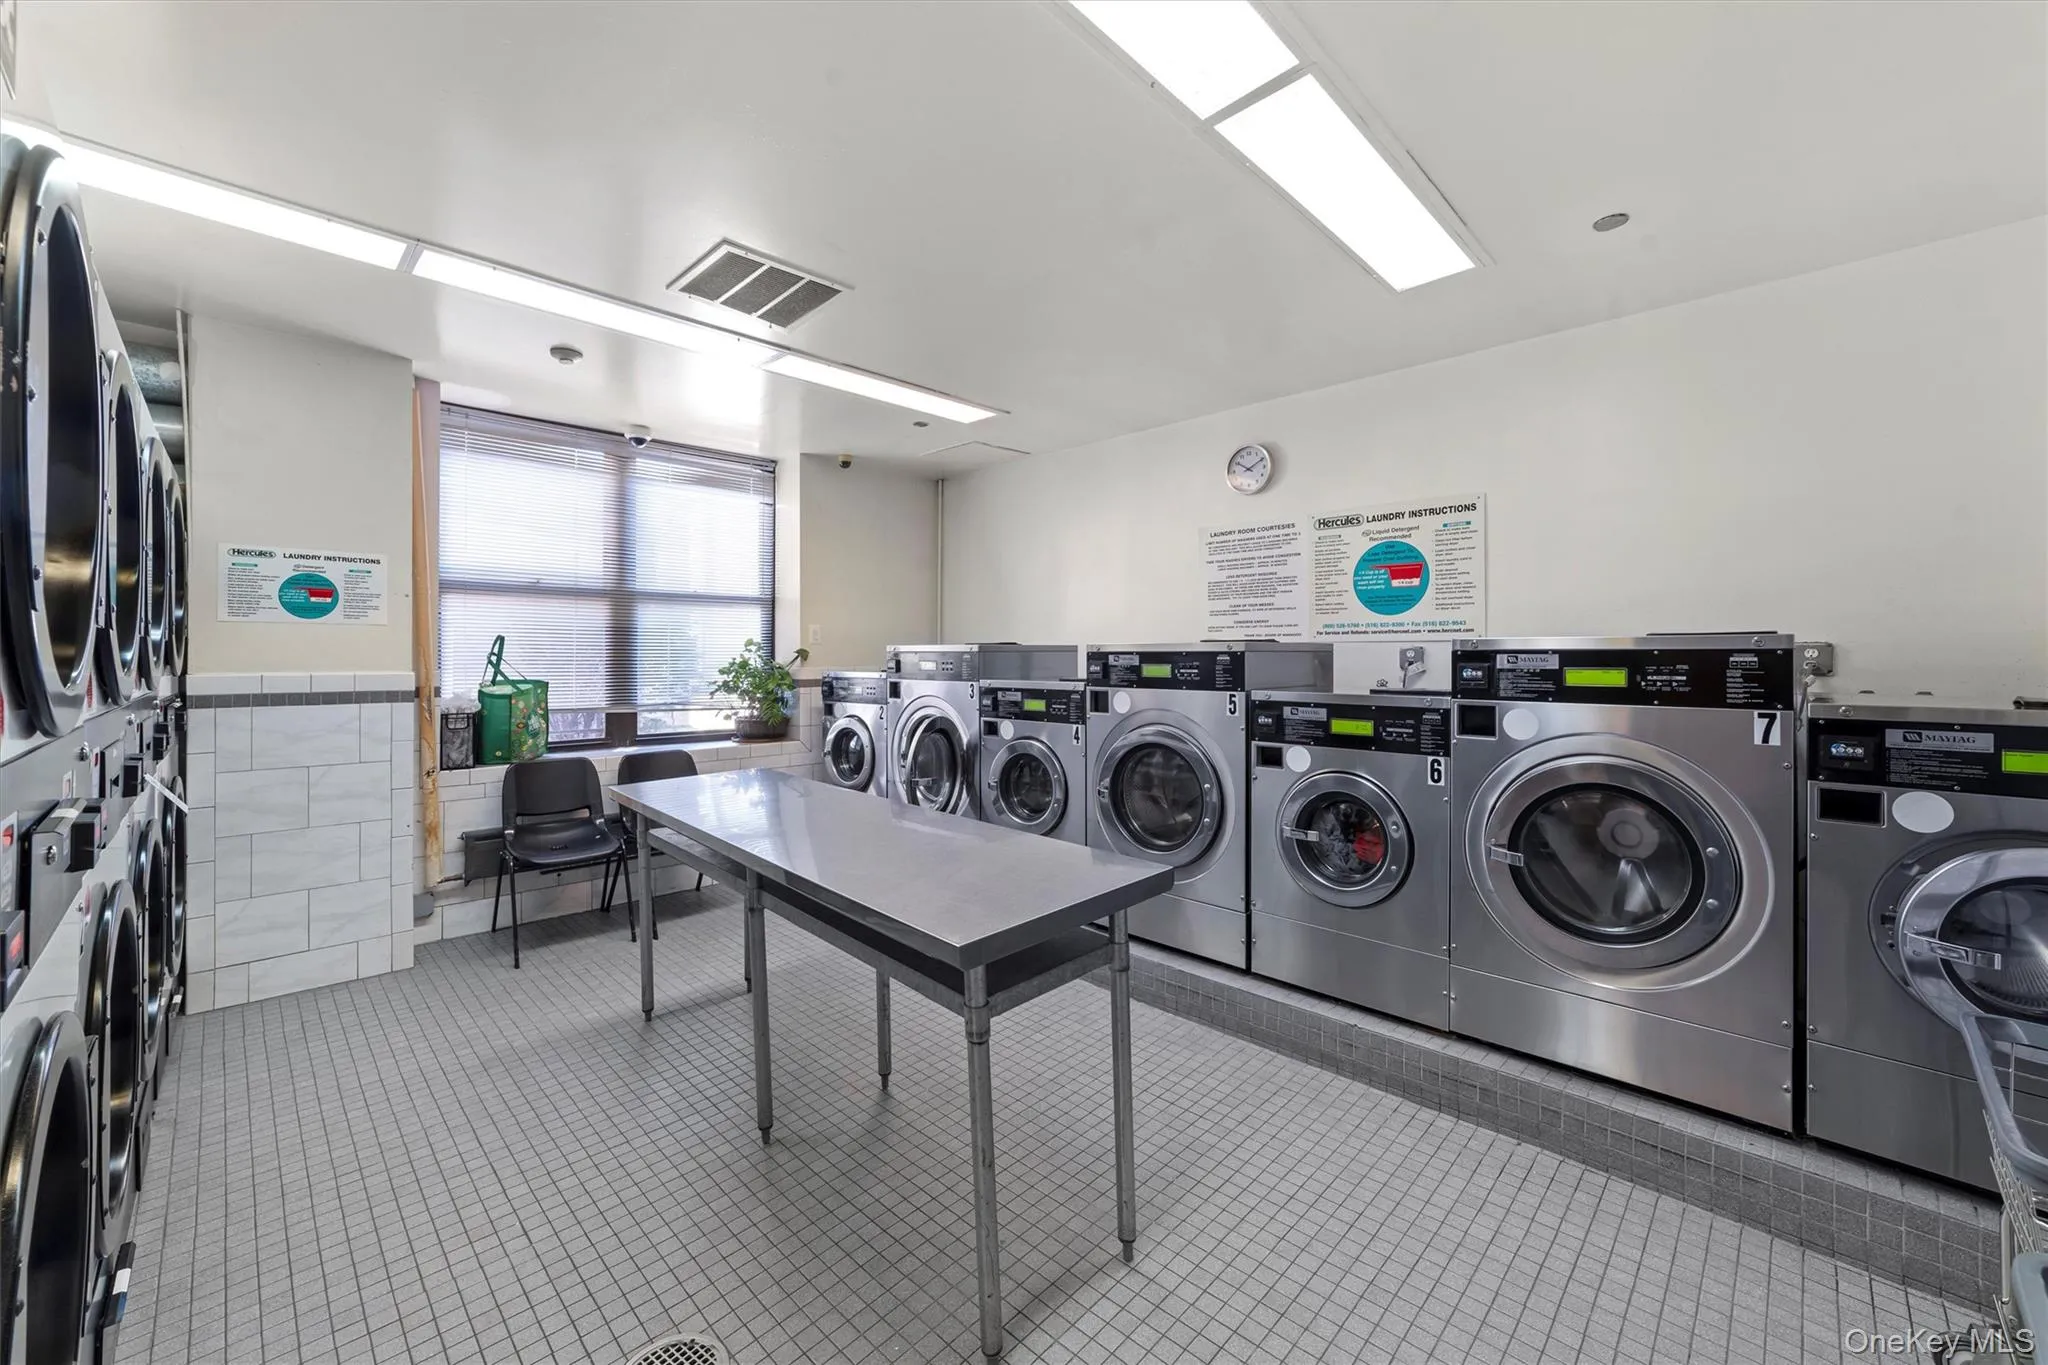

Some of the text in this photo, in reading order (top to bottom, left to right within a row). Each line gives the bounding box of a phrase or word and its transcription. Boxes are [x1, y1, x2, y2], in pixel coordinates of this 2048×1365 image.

[1318, 502, 1477, 528] Hercules LAUNDRY INSTRUCTIONS
[1209, 522, 1296, 538] LAUNDRY ROOM COURTESIES
[1369, 532, 1412, 542] Recommended
[1371, 528, 1390, 536] Liquid
[1391, 525, 1420, 534] Detergent
[232, 548, 273, 558] Hercules
[283, 552, 381, 565] LAUNDRY INSTRUCTIONS
[969, 683, 975, 699] 3
[1228, 693, 1237, 715] 5
[879, 706, 885, 720] 2
[1073, 726, 1080, 745] 4
[1757, 712, 1778, 745] 7
[1924, 734, 1976, 745] MAYTAG
[1430, 758, 1442, 784] 6
